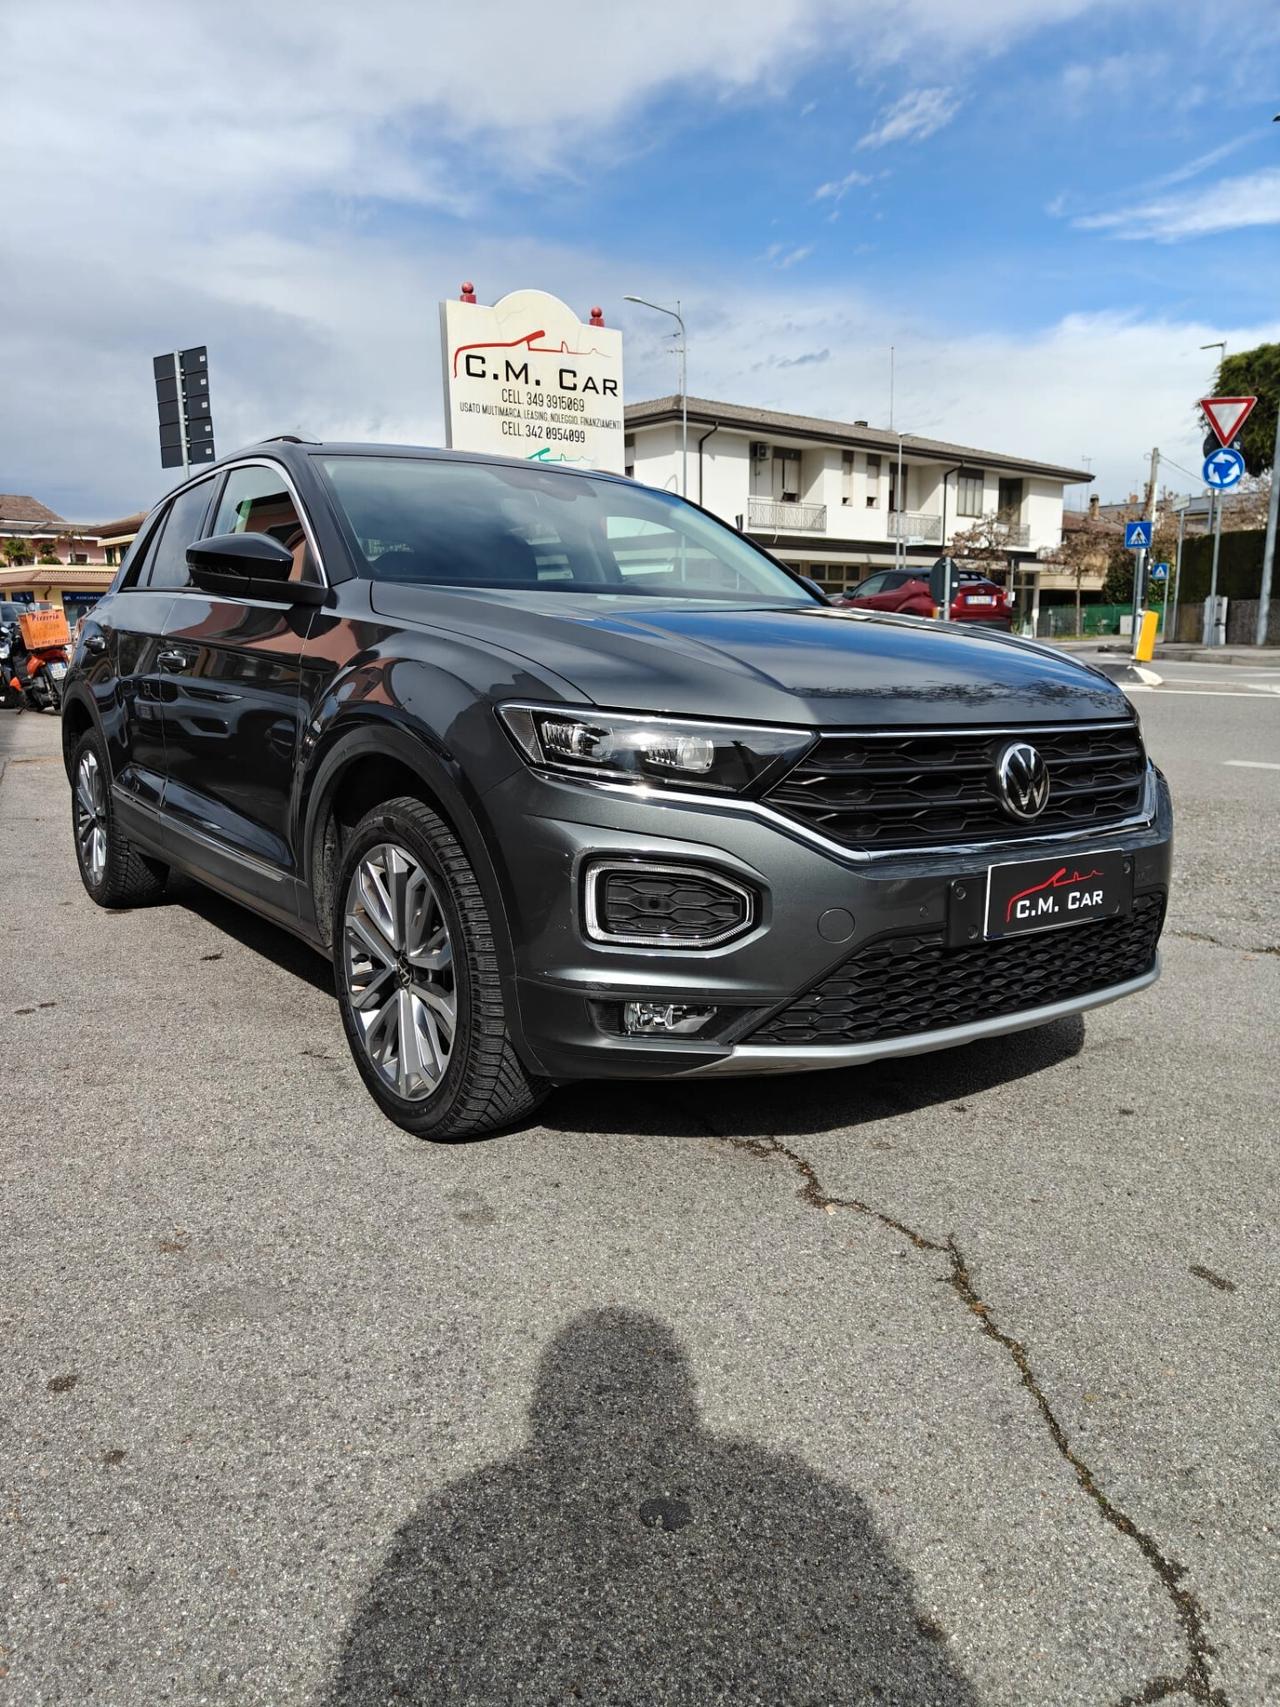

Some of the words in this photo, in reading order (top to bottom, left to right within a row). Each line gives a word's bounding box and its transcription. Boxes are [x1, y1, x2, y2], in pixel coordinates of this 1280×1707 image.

[465, 354, 541, 386] C.M.
[559, 368, 618, 397] CAR
[501, 388, 524, 404] CELL.
[526, 391, 544, 407] 349
[546, 394, 585, 412] 3915069
[460, 402, 480, 414] USATO
[580, 416, 622, 430] FINANZIAMENTI
[501, 421, 524, 437] CELL.
[525, 424, 543, 439] 342
[545, 426, 585, 443] 0954099
[1016, 896, 1059, 918] C.M.
[1068, 890, 1103, 909] CAR
